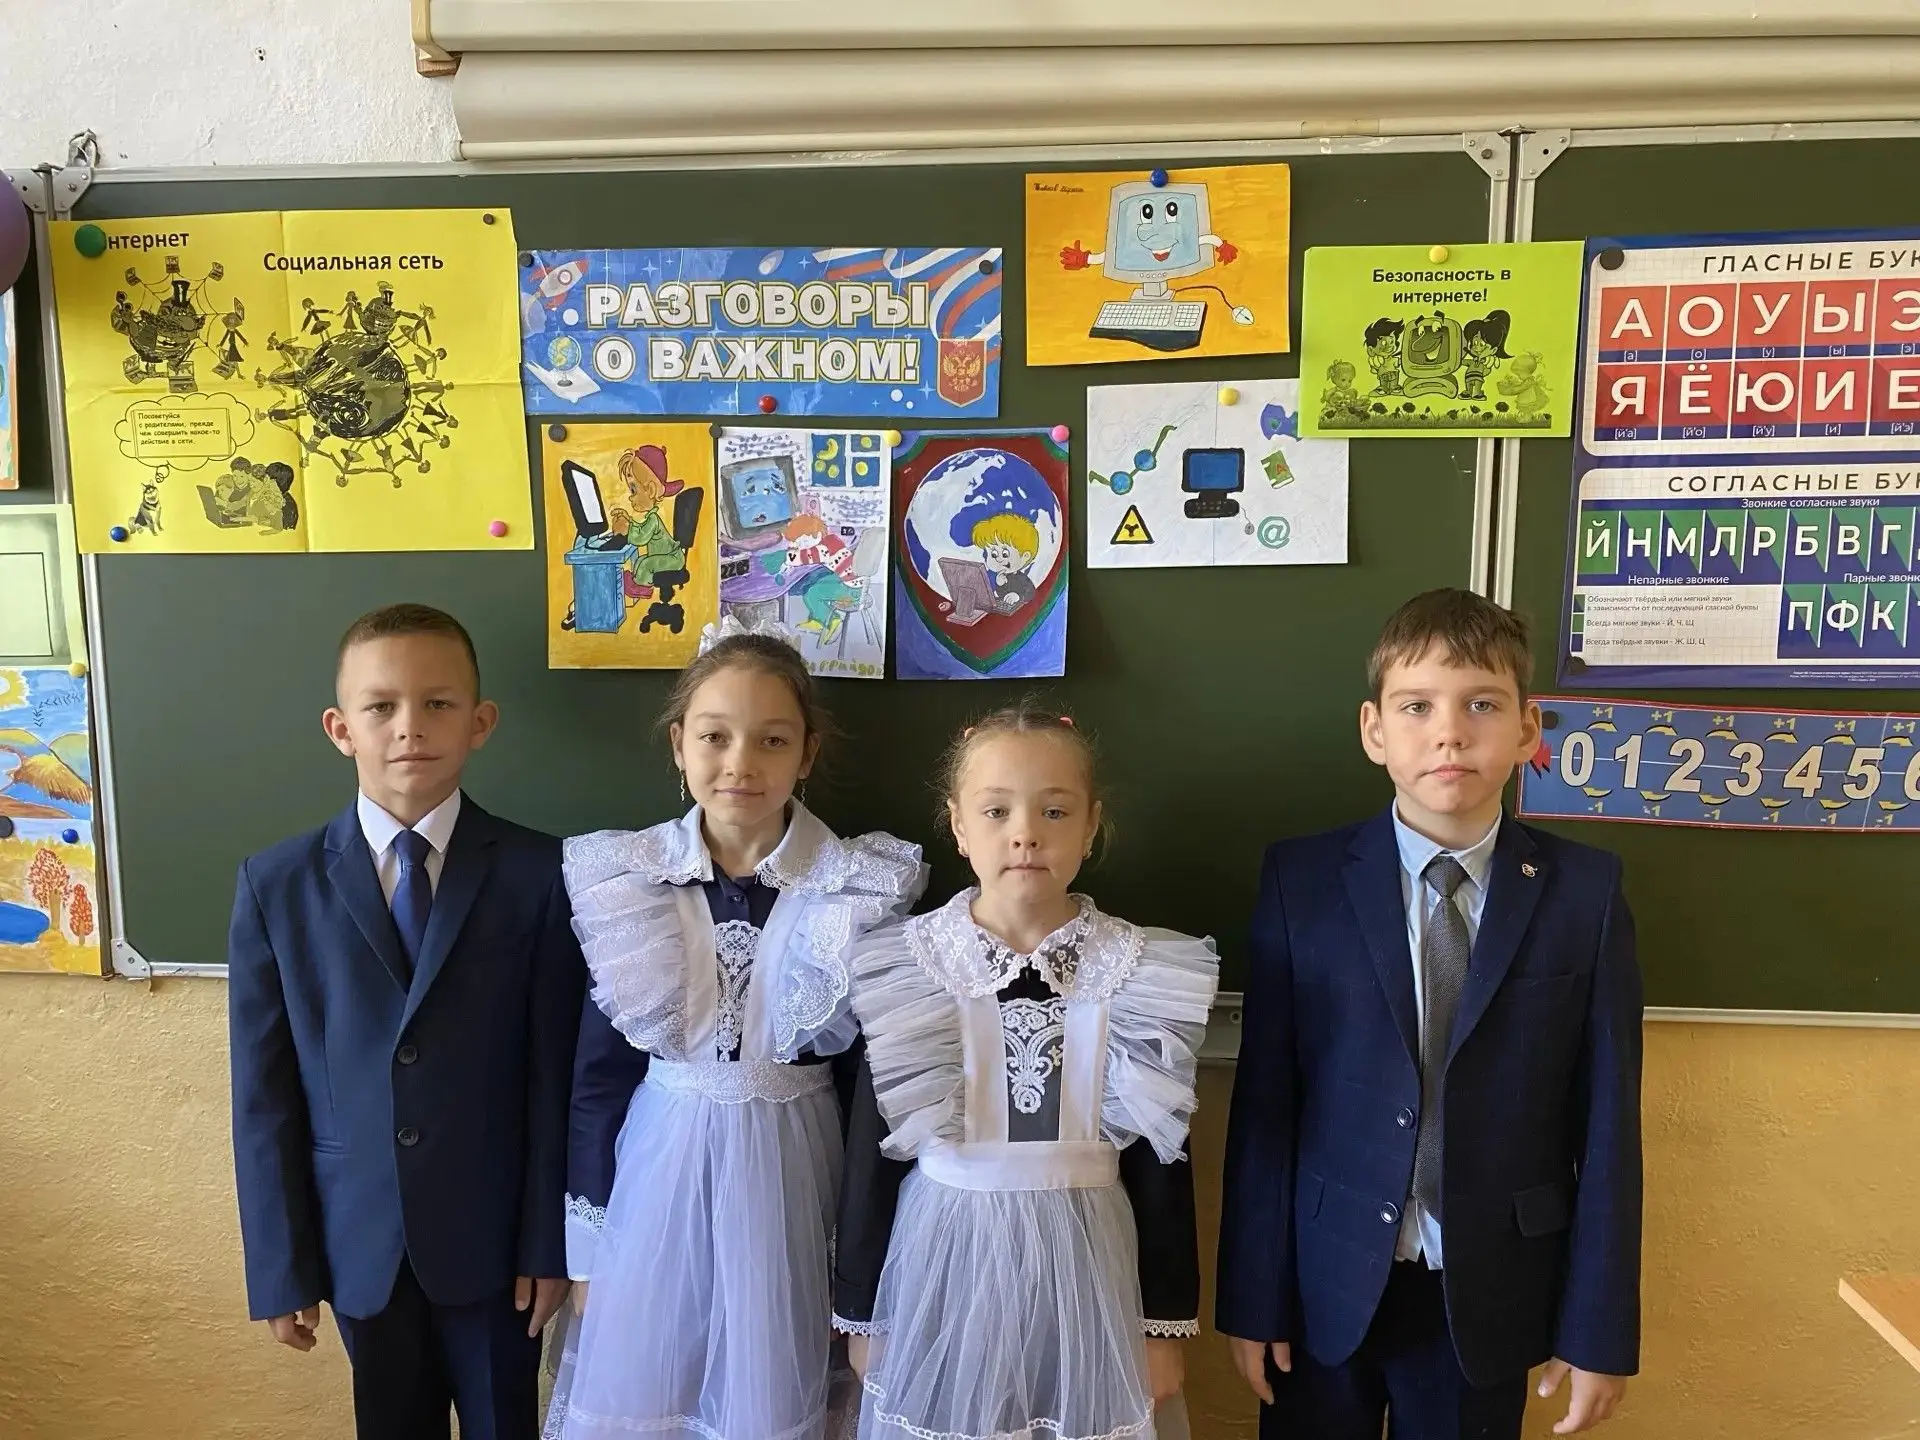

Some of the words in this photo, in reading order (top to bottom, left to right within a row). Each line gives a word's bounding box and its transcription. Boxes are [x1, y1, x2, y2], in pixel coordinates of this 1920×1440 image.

[107, 233, 189, 252] нтернет
[263, 253, 391, 274] Социальная
[399, 255, 443, 269] сеть
[1703, 251, 1853, 273] ГЛАСНЫЕ
[1373, 268, 1495, 283] Безопасность
[1501, 270, 1511, 280] в
[586, 281, 930, 328] РАЗГОВОРЫ
[1393, 288, 1488, 306] интернете!
[1610, 299, 1653, 339] А
[1678, 296, 1724, 337] О
[1752, 293, 1792, 335] У
[1813, 292, 1866, 333] Ы
[594, 336, 637, 381] О
[649, 337, 920, 383] ВАЖНОМ!
[1611, 375, 1647, 415] Я
[1679, 364, 1712, 414] Ё
[1736, 372, 1795, 412] Ю
[1815, 370, 1855, 411] И
[1889, 369, 1920, 410] Е
[1668, 473, 1859, 492] СОГЛАСНЫЕ
[1741, 498, 1787, 508] Звонкие
[1789, 498, 1847, 507] согласные
[1849, 498, 1880, 508] звуки
[1585, 520, 1611, 558] Й
[1627, 528, 1652, 557] Н
[1666, 527, 1696, 557] М
[1709, 526, 1738, 557] Л
[1752, 526, 1777, 556] Р
[1794, 525, 1819, 556] Б
[1837, 525, 1861, 555] В
[1881, 524, 1902, 554] Г
[1628, 576, 1684, 586] Непарные
[1685, 575, 1729, 584] звонкие
[1844, 573, 1885, 584] Парные
[1787, 602, 1814, 631] П
[1826, 600, 1859, 632] Ф
[1872, 601, 1897, 631] К
[1592, 706, 1613, 719] +1
[1651, 710, 1673, 723] +1
[1712, 714, 1735, 727] +1
[1773, 717, 1796, 730] +1
[1834, 720, 1856, 732] +1
[1893, 721, 1916, 733] +1
[1559, 730, 1596, 788] 0
[1614, 734, 1643, 789] 1
[1664, 737, 1706, 793] 2
[1724, 741, 1764, 797] 3
[1782, 744, 1825, 798] 4
[1842, 747, 1886, 800] 5
